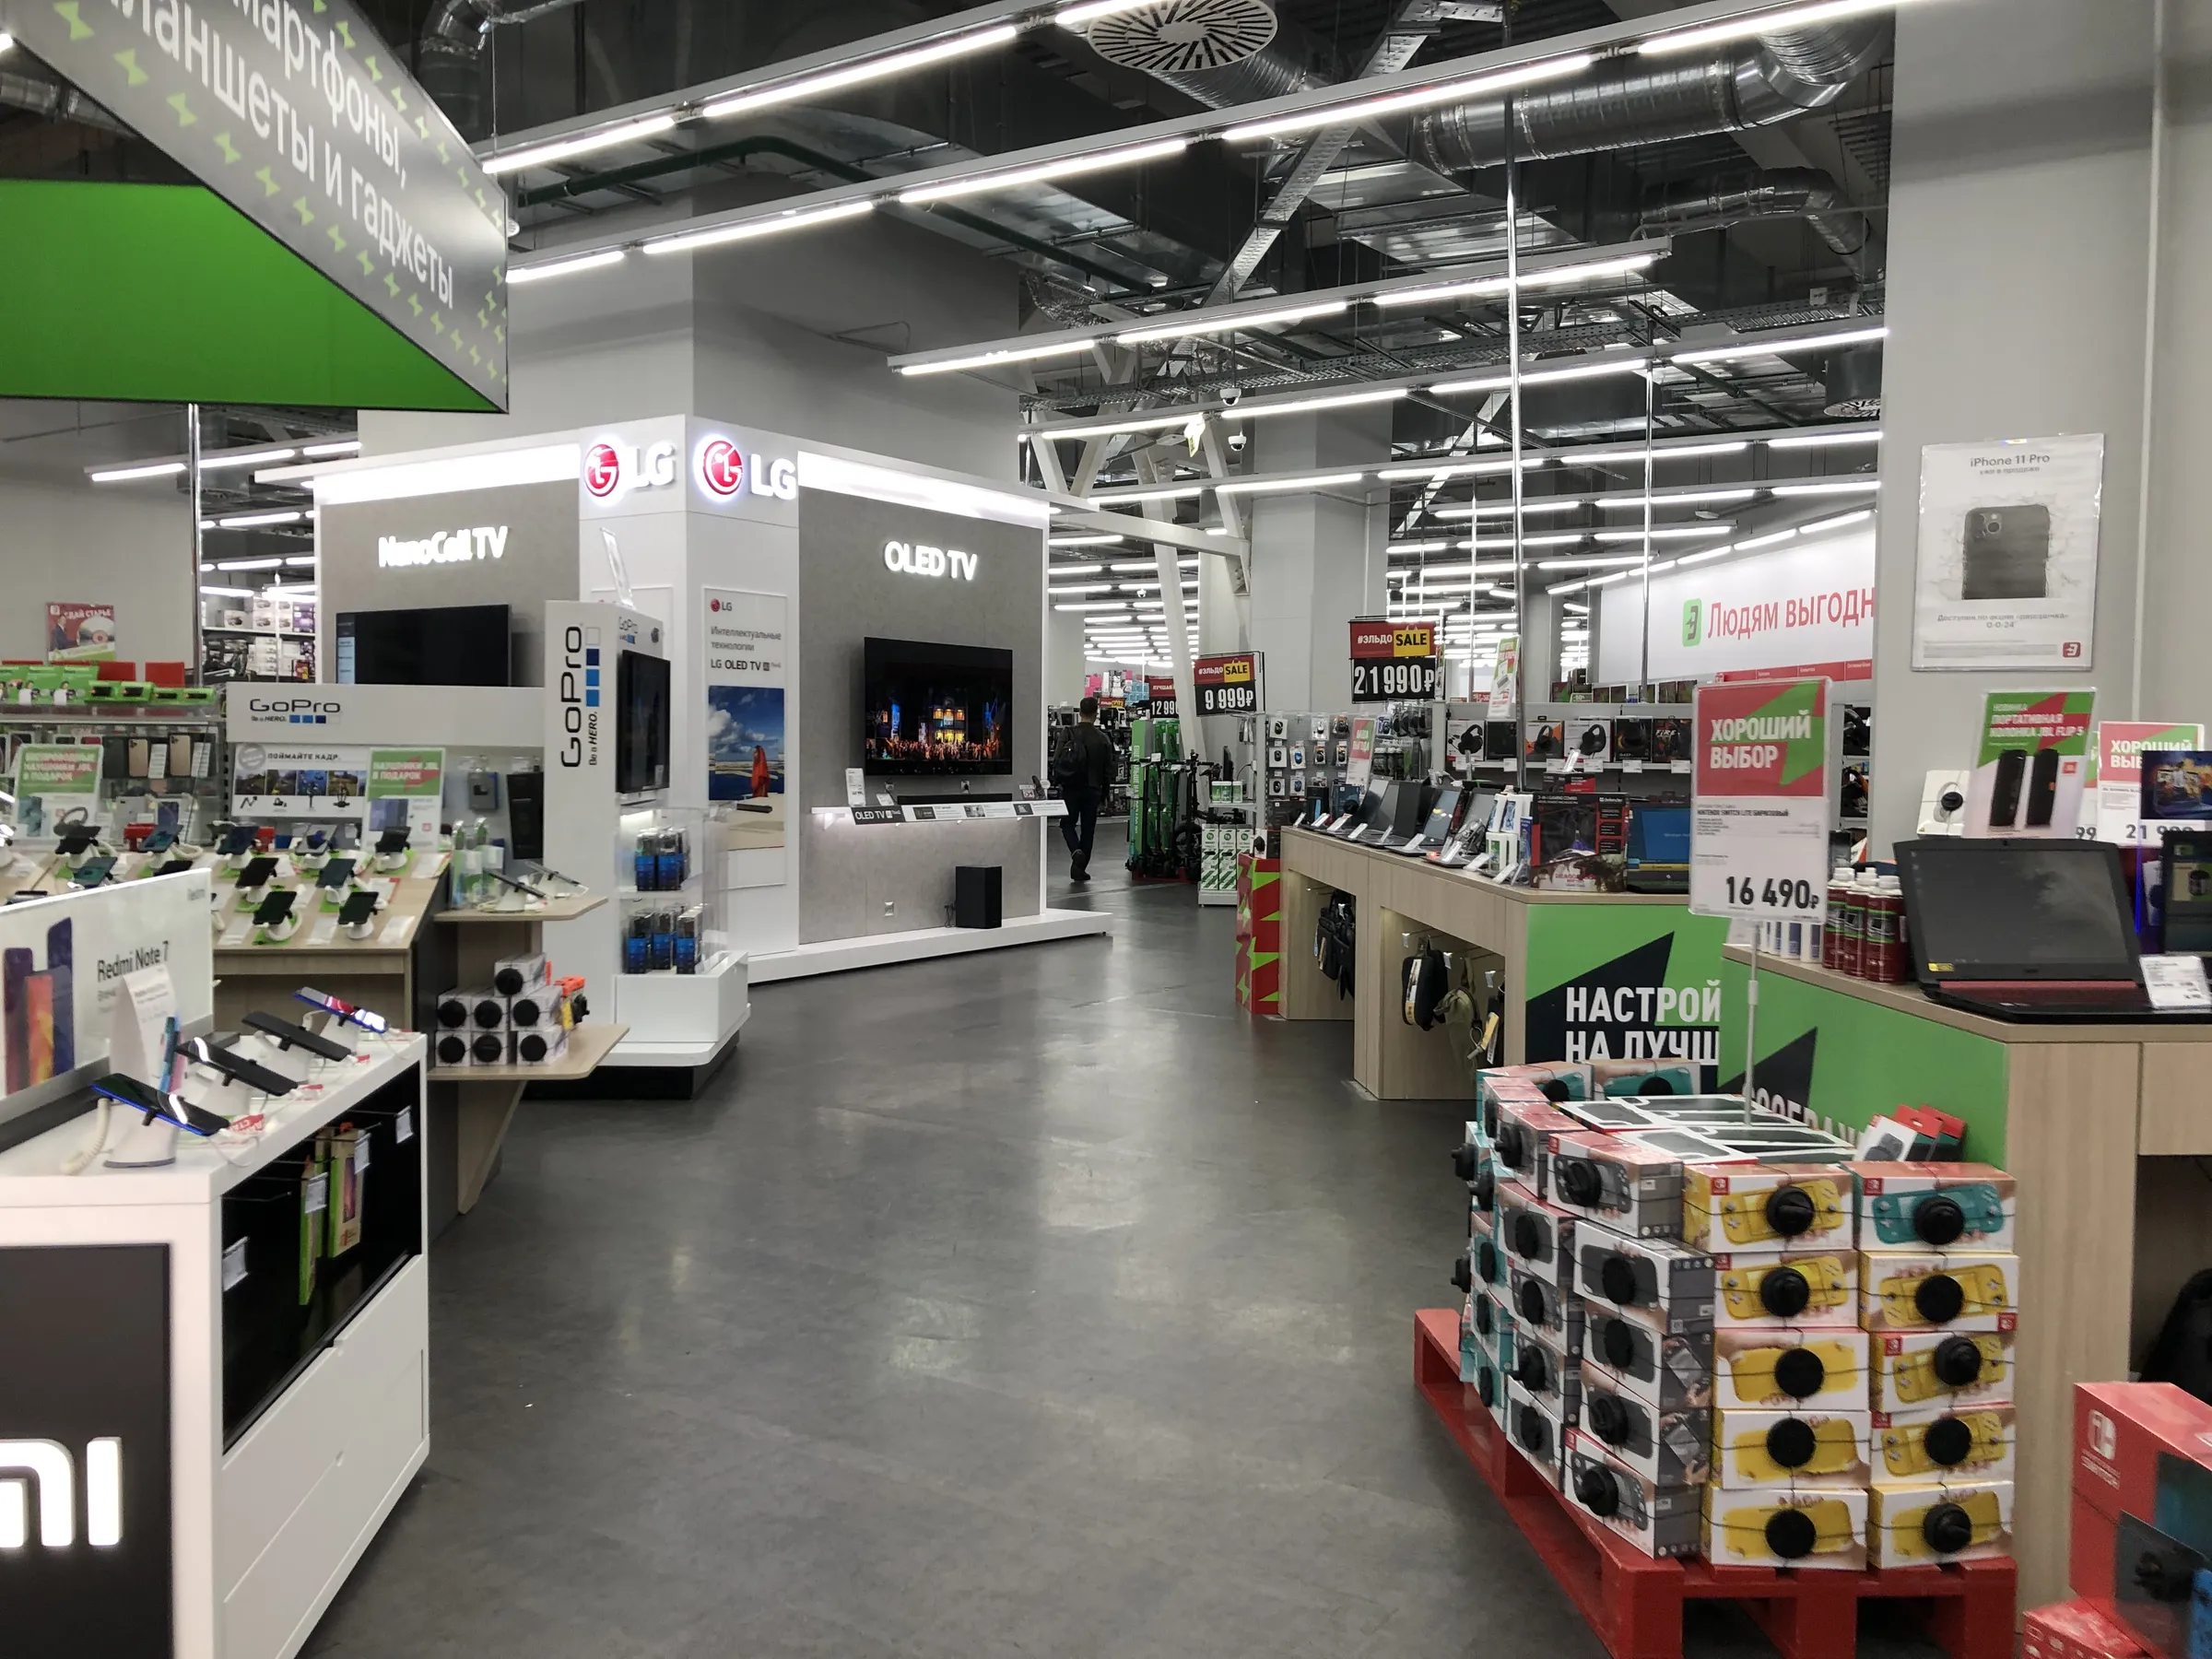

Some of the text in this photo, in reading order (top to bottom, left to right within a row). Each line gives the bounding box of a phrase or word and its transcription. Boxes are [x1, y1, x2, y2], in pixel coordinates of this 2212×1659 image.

[324, 140, 342, 207] и
[351, 166, 453, 310] гаджеты
[623, 440, 677, 488] LG
[1971, 453, 2051, 467] iPhone 11 Pro
[750, 453, 797, 500] LG
[472, 525, 509, 559] TV
[885, 541, 978, 581] OLED TV
[722, 602, 733, 611] LG
[1707, 601, 1779, 640] Людям
[711, 626, 782, 641] Интеллектуальные
[1358, 632, 1427, 646] #ЭЛЬДО SALE
[711, 658, 723, 669] LG
[724, 659, 747, 670] OLED
[749, 661, 762, 671] TV
[1198, 665, 1248, 676] #ЭЛЬДО SALE
[1354, 665, 1379, 694] 21
[250, 698, 341, 713] GoPro
[560, 626, 582, 768] GoPro
[1152, 700, 1161, 715] 12
[1205, 689, 1214, 711] 9
[588, 712, 598, 746] HERO.
[1710, 710, 1812, 742] ХОРОШИЙ
[268, 752, 312, 760] ПОЙМАЙТЕ
[589, 752, 597, 766] Be
[1710, 745, 1779, 770] ВЫБОР
[854, 810, 875, 820] OLED
[875, 810, 885, 819] TV
[1726, 877, 1754, 905] 16
[97, 940, 170, 983] Redmi Note 7
[1566, 979, 1721, 1022] НАСТРОЙ
[1566, 1030, 1611, 1064] НА
